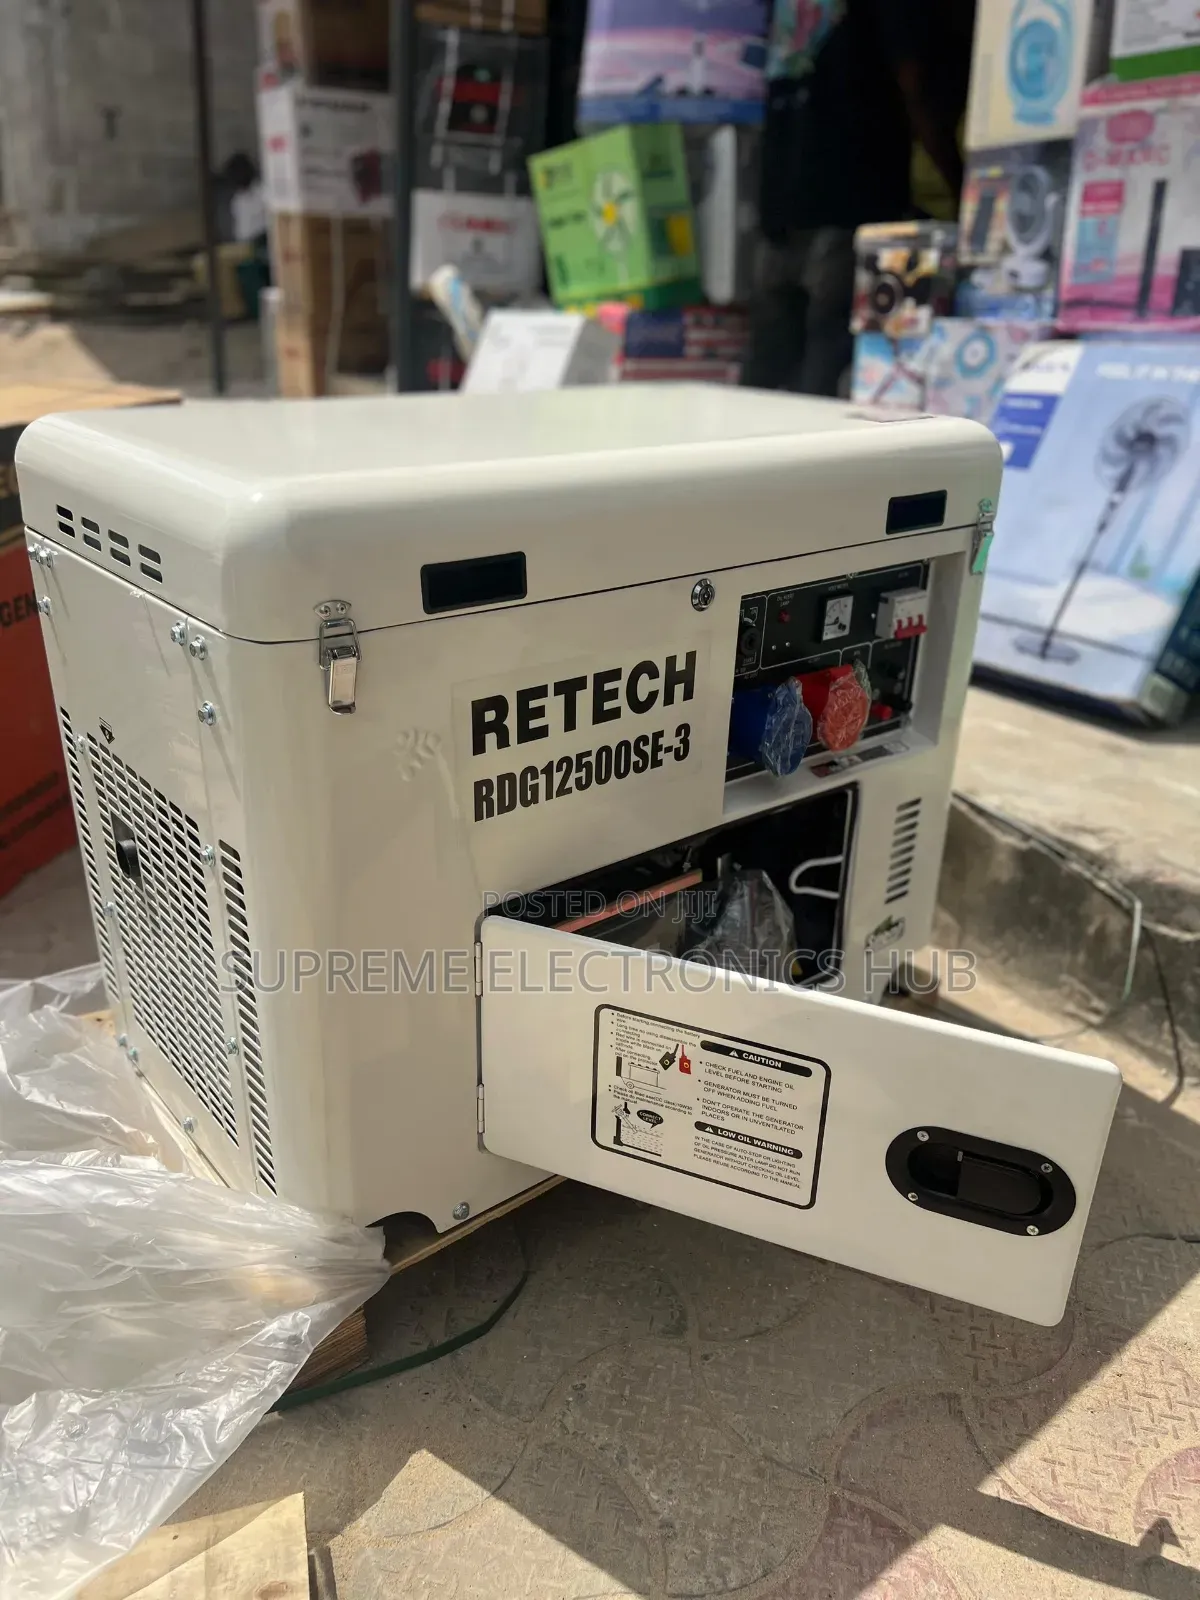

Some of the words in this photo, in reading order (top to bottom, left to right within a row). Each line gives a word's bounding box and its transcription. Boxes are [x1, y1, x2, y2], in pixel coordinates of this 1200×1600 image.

[471, 650, 697, 756] RETECH
[474, 722, 691, 822] RDG12500SE-3
[705, 1060, 726, 1071] CHECK
[727, 1066, 743, 1076] FUEL
[744, 1071, 757, 1080] AND
[758, 1075, 782, 1087] ENGINE
[742, 1052, 782, 1068] CAUTION
[704, 1067, 723, 1077] LEVEL
[724, 1072, 749, 1084] BEFORE
[751, 1080, 782, 1093] STARTING
[703, 1079, 741, 1095] GENERATOR
[742, 1090, 759, 1100] MUST
[761, 1095, 769, 1103] BE
[771, 1098, 797, 1111] TURNED
[703, 1086, 715, 1094] OFF
[716, 1090, 735, 1100] WHEN
[735, 1095, 760, 1107] ADDING
[761, 1102, 777, 1112] FUEL
[701, 1110, 725, 1122] PLACES
[701, 1104, 730, 1116] INDOORS
[749, 1117, 795, 1135] UNVENTILATED
[721, 1103, 750, 1115] OPERATE
[751, 1111, 763, 1120] THE
[764, 1115, 804, 1131] GENERATOR
[717, 1128, 736, 1139] LOW
[737, 1134, 752, 1143] OIL
[752, 1138, 793, 1156] WARNING
